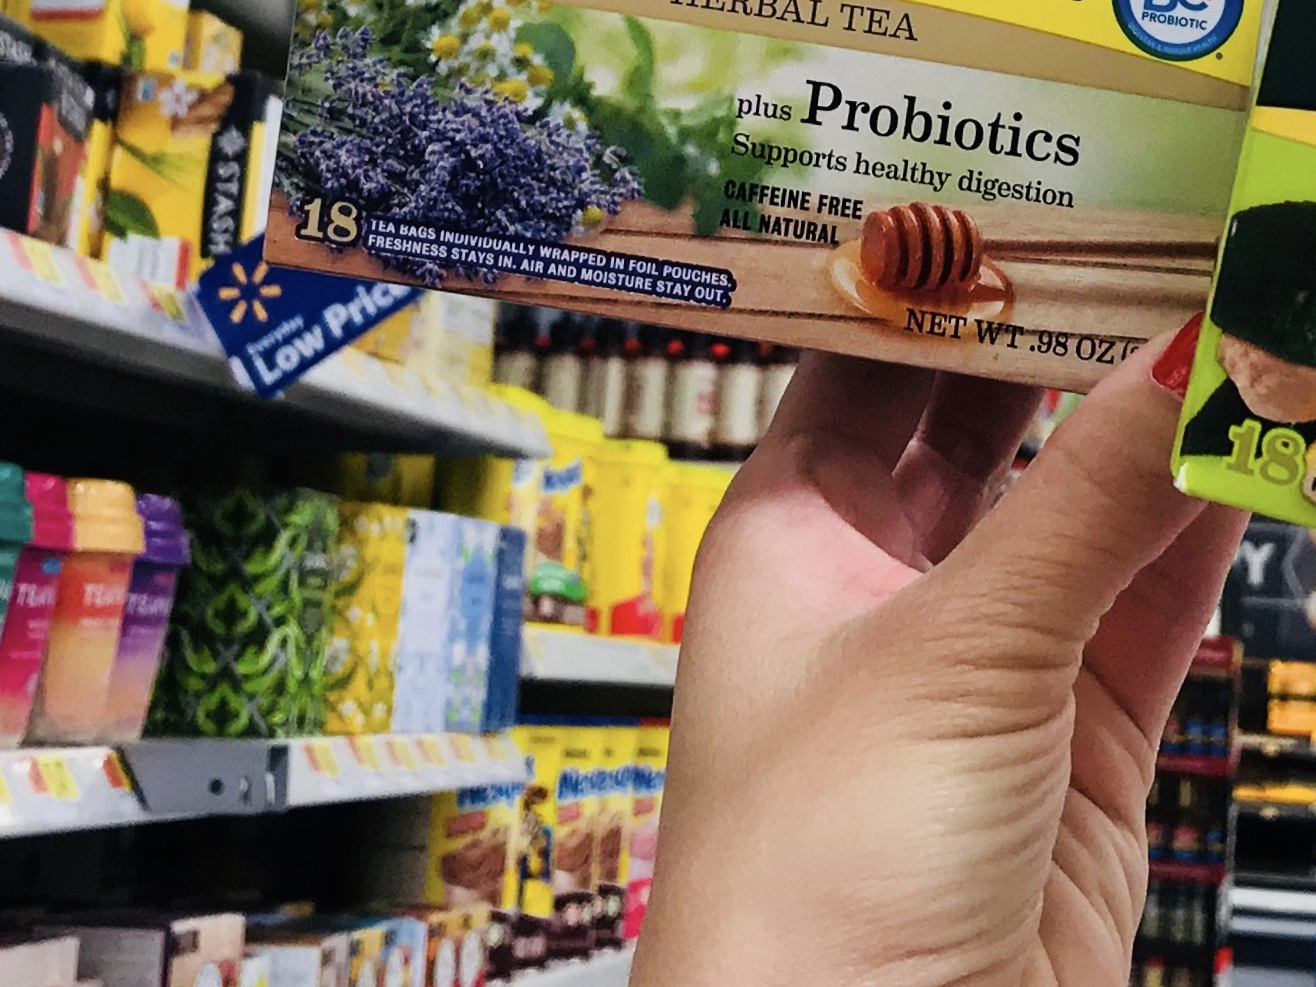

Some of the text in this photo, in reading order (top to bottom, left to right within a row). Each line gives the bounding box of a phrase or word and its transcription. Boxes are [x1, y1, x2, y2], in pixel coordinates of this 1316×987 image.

[840, 3, 918, 42] TEA
[1141, 11, 1208, 31] PROBIOTIC
[736, 79, 1081, 167] plus Probiotics
[724, 179, 864, 219] CAFFEINE FREE
[730, 132, 1075, 209] Supports healthy digestion
[300, 199, 358, 243] 18
[719, 212, 840, 245] ALL NATURAL
[368, 235, 727, 304] FRESHNESS STAYS IN. AIR AND MOISTURE STAY OUT.
[370, 218, 733, 288] TEA BAGS INDIVIDUALLY WRAPPED IN FOIL POUCHES.
[249, 325, 325, 386] Low
[903, 307, 967, 339] NET
[974, 317, 1024, 349] WT
[1029, 329, 1068, 357] .98
[1075, 336, 1115, 364] OZ
[1224, 417, 1307, 488] 18
